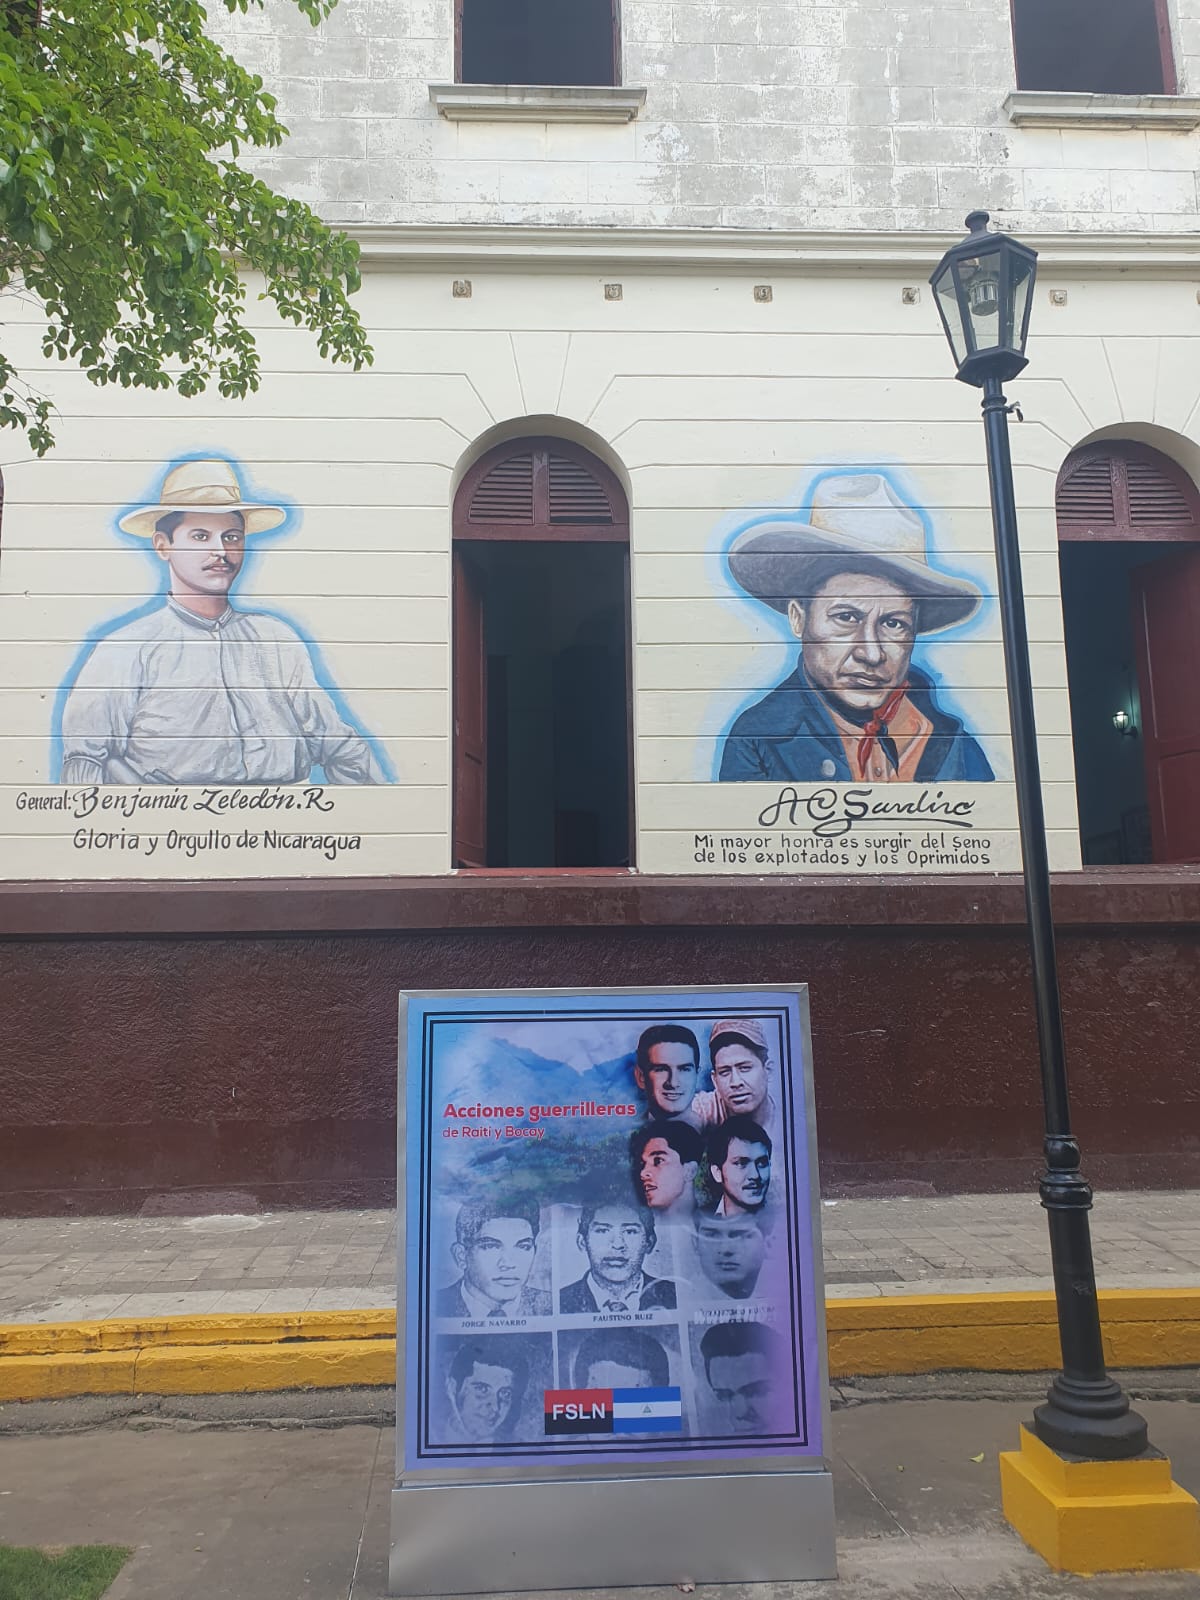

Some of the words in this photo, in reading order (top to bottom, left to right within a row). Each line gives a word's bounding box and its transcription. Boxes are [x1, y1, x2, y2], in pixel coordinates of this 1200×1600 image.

[73, 828, 139, 849] Gloria
[145, 837, 158, 856] y
[167, 829, 231, 857] Orgullo
[236, 829, 259, 849] de
[264, 829, 361, 860] Nicaragua
[694, 834, 714, 849] Mi
[721, 837, 772, 850] mayor
[781, 833, 833, 849] honra
[839, 837, 859, 849] es
[864, 832, 912, 853] surgir
[921, 832, 945, 849] del
[952, 836, 991, 849] Seno
[694, 848, 715, 863] de
[723, 848, 747, 863] los
[754, 848, 850, 866] explotados
[856, 853, 867, 867] y
[874, 850, 899, 864] los
[907, 849, 990, 868] Oprimidos
[443, 1103, 525, 1119] Acciones
[529, 1101, 637, 1123] guerrilleras
[442, 1126, 459, 1138] de
[462, 1126, 492, 1138] Raiti
[495, 1129, 502, 1141] y
[505, 1126, 545, 1141] Bocay
[461, 1320, 486, 1328] JORGE
[488, 1319, 527, 1327] NAVARRO
[593, 1314, 632, 1322] FAUSTINO
[635, 1313, 653, 1321] RUIZ
[552, 1402, 605, 1421] FSLN
